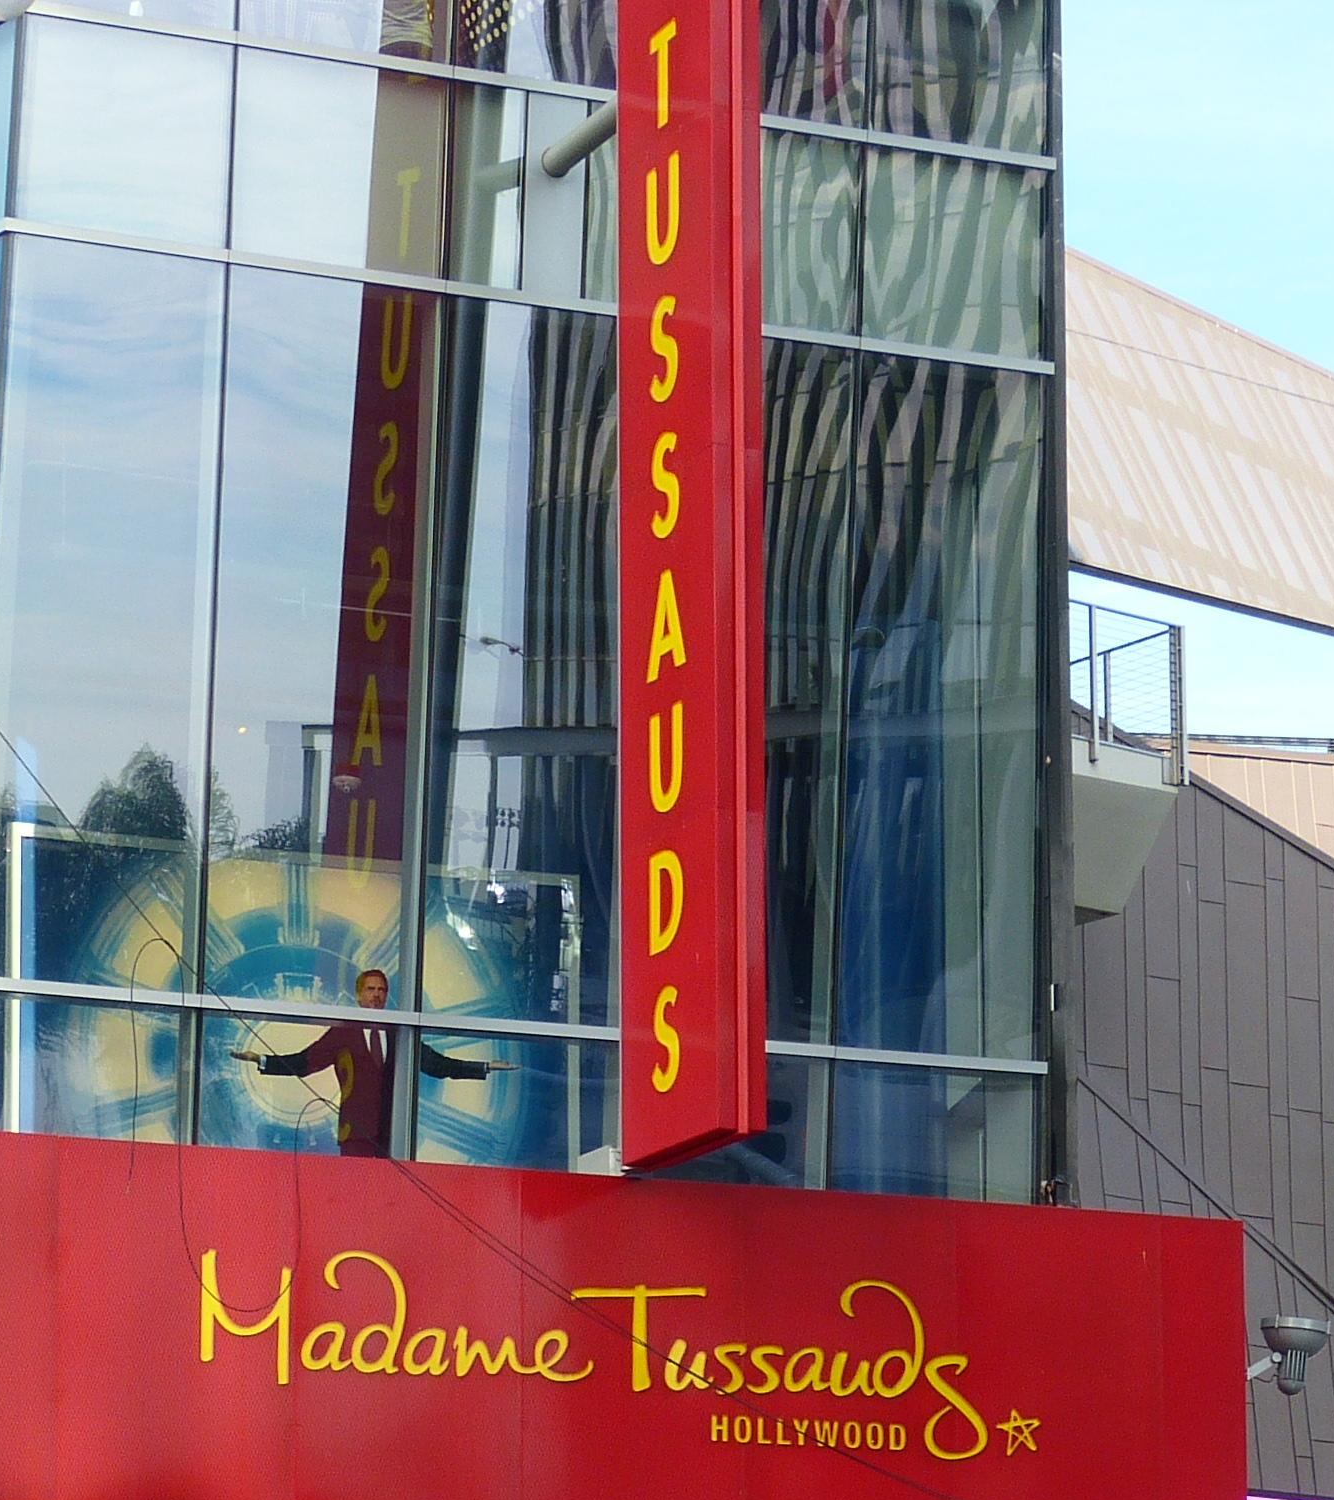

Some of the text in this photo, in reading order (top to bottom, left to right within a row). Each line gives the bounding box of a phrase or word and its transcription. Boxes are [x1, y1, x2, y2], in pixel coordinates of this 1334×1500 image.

[645, 17, 688, 1093] TUSSAUDS
[199, 1248, 989, 1461] Madame Tussauds
[709, 1413, 907, 1452] HOLLYWOOD
